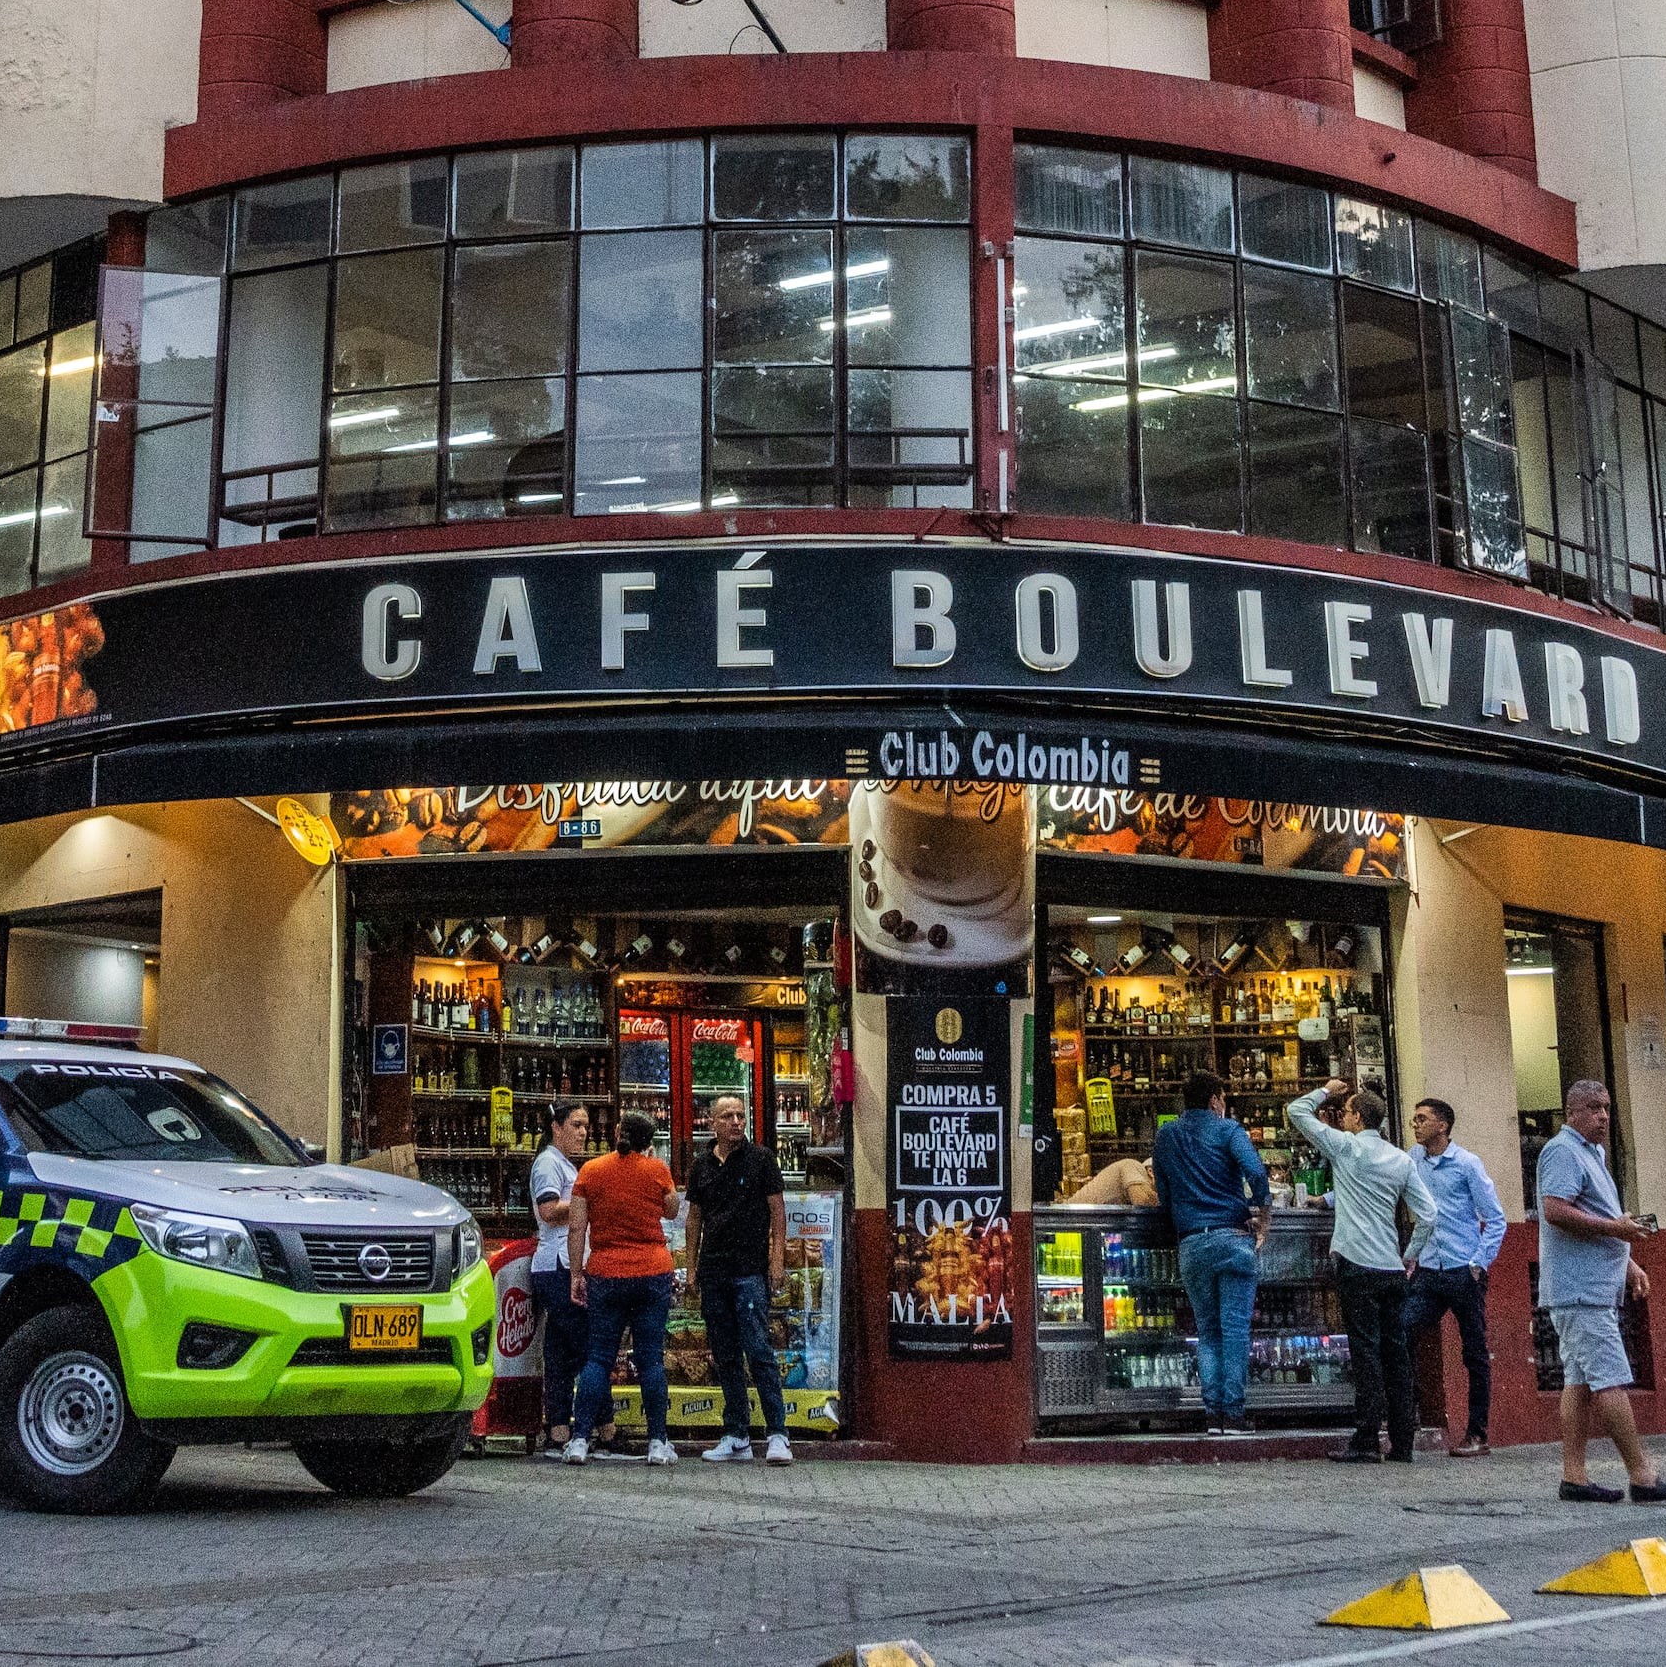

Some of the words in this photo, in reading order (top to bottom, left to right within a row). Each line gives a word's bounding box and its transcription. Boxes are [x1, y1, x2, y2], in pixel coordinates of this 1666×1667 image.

[361, 550, 775, 682] CAFÉ
[890, 568, 1641, 746] BOULEVARD
[880, 731, 960, 779] Club
[971, 731, 1130, 784] Colombia
[562, 822, 598, 835] 8-86
[776, 987, 807, 1006] Club
[915, 1048, 937, 1061] Club
[939, 1047, 984, 1062] Colombia
[31, 1064, 185, 1082] POLICÍA
[902, 1085, 982, 1106] COMPRA
[985, 1085, 997, 1106] 5
[929, 1113, 970, 1134] CAFÉ
[902, 1133, 997, 1152] BOULEVARD
[912, 1151, 931, 1168] TE
[934, 1151, 988, 1169] INVITA
[933, 1168, 953, 1186] LA
[956, 1168, 968, 1186] 6
[788, 1212, 831, 1225] IQOS
[892, 1196, 1009, 1238] 100%
[889, 1291, 1013, 1326] MALTA
